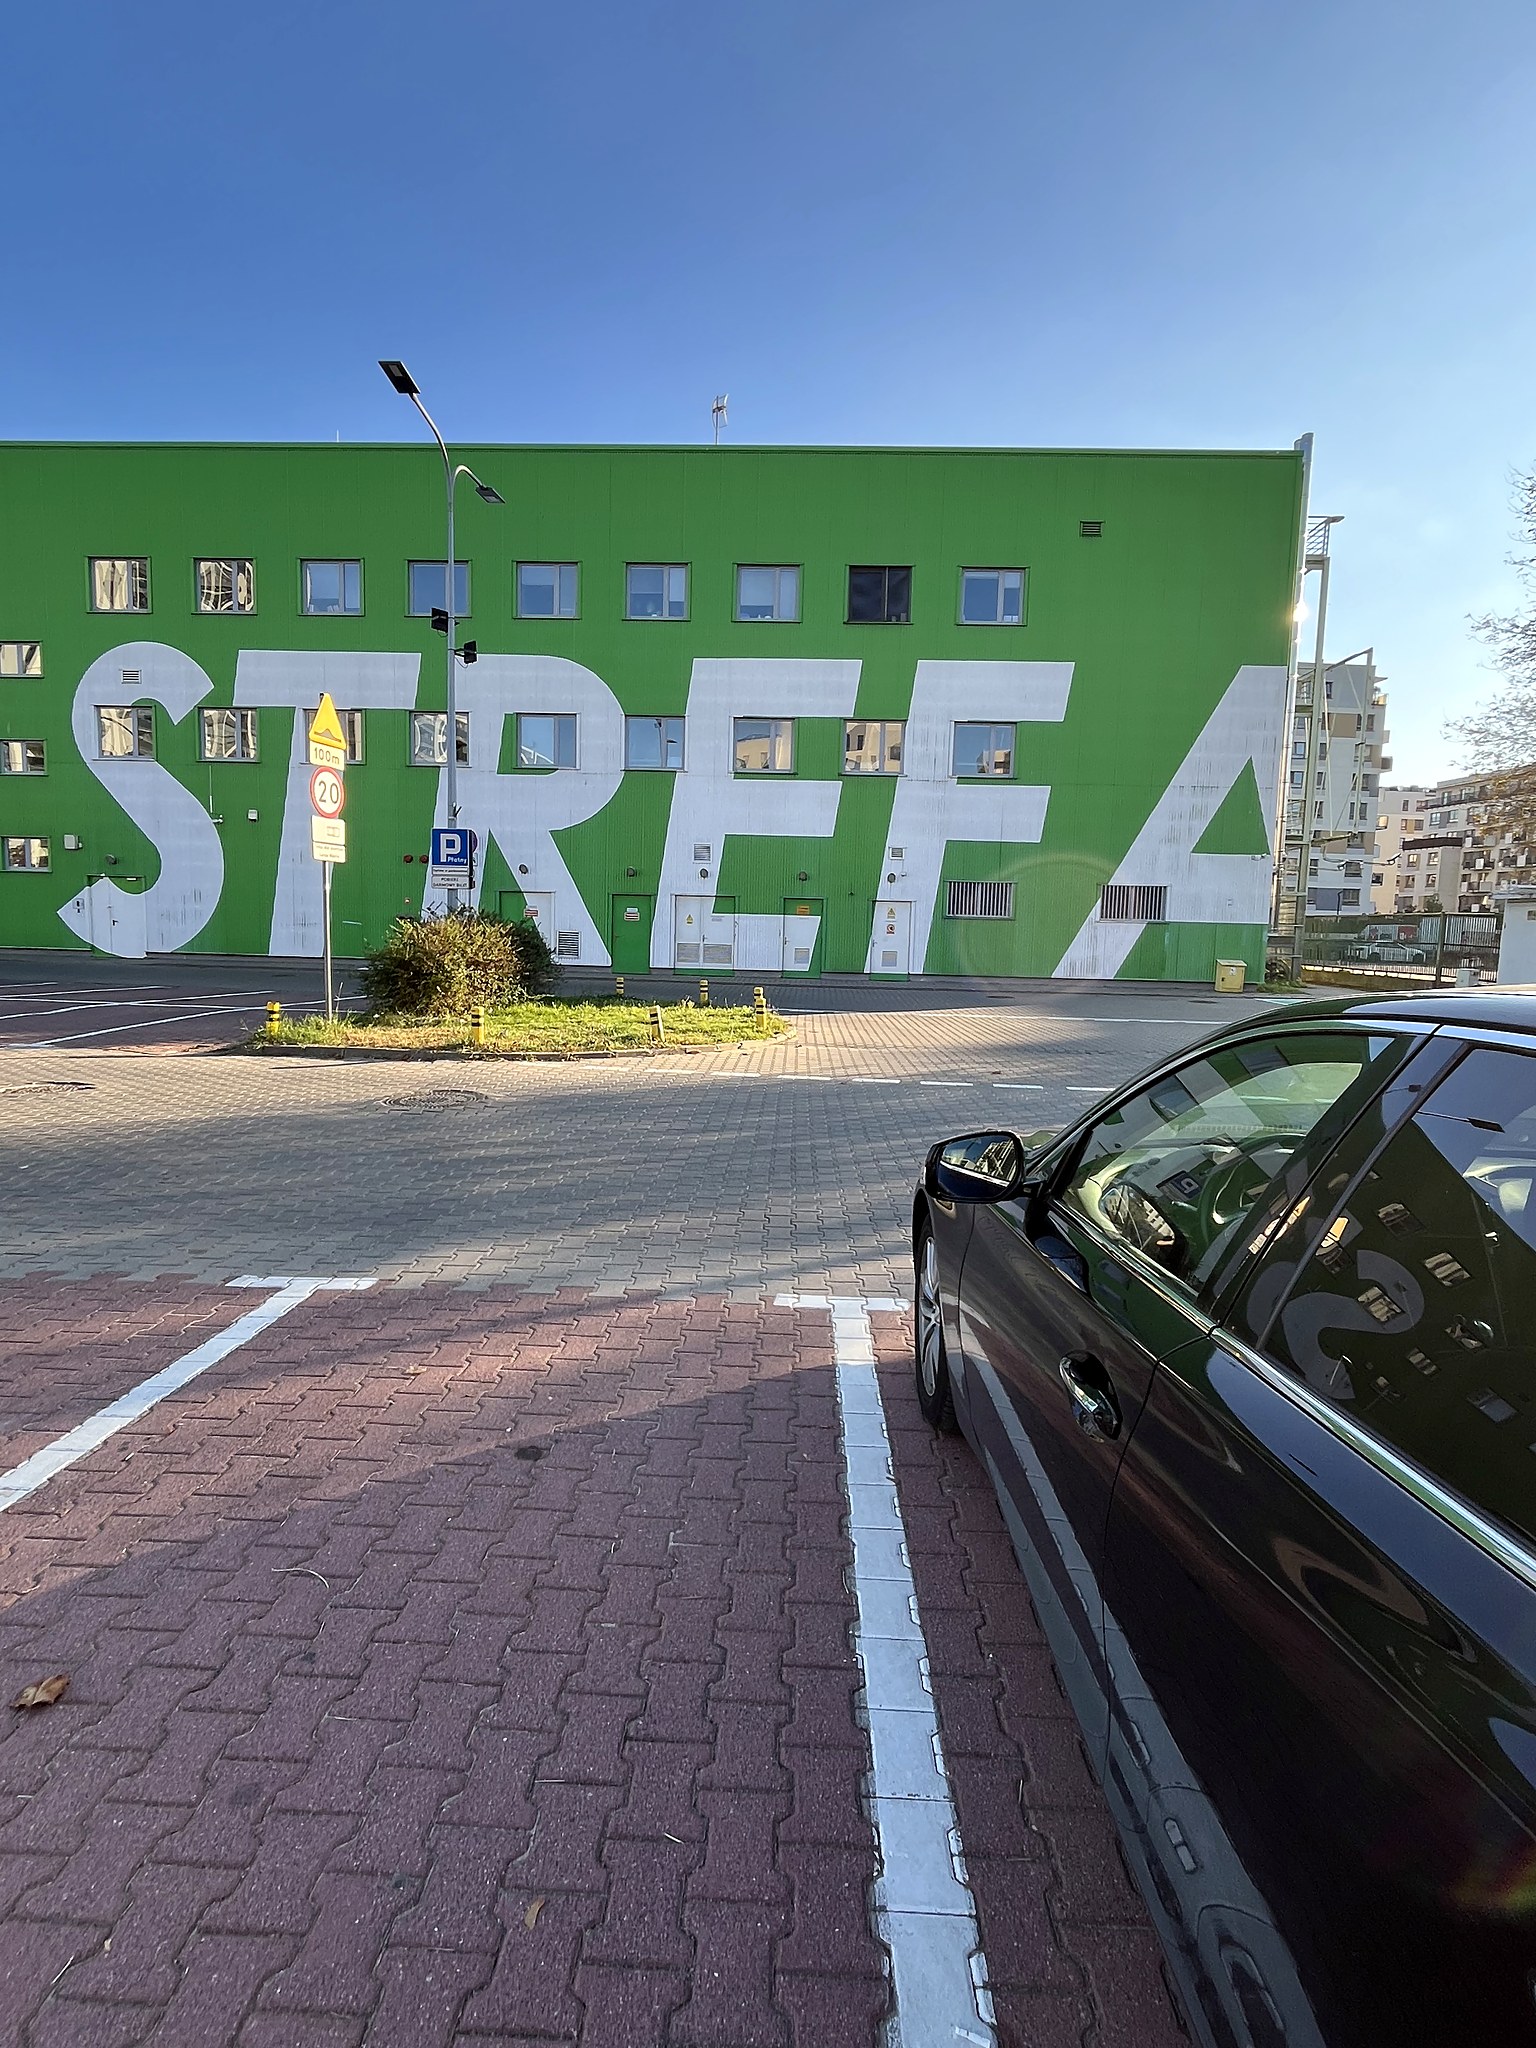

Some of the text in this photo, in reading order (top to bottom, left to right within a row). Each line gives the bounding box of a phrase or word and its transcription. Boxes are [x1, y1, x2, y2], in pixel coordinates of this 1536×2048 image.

[314, 747, 340, 765] 100m
[318, 780, 339, 804] 20
[57, 641, 1288, 981] STREFA
[440, 833, 461, 863] P
